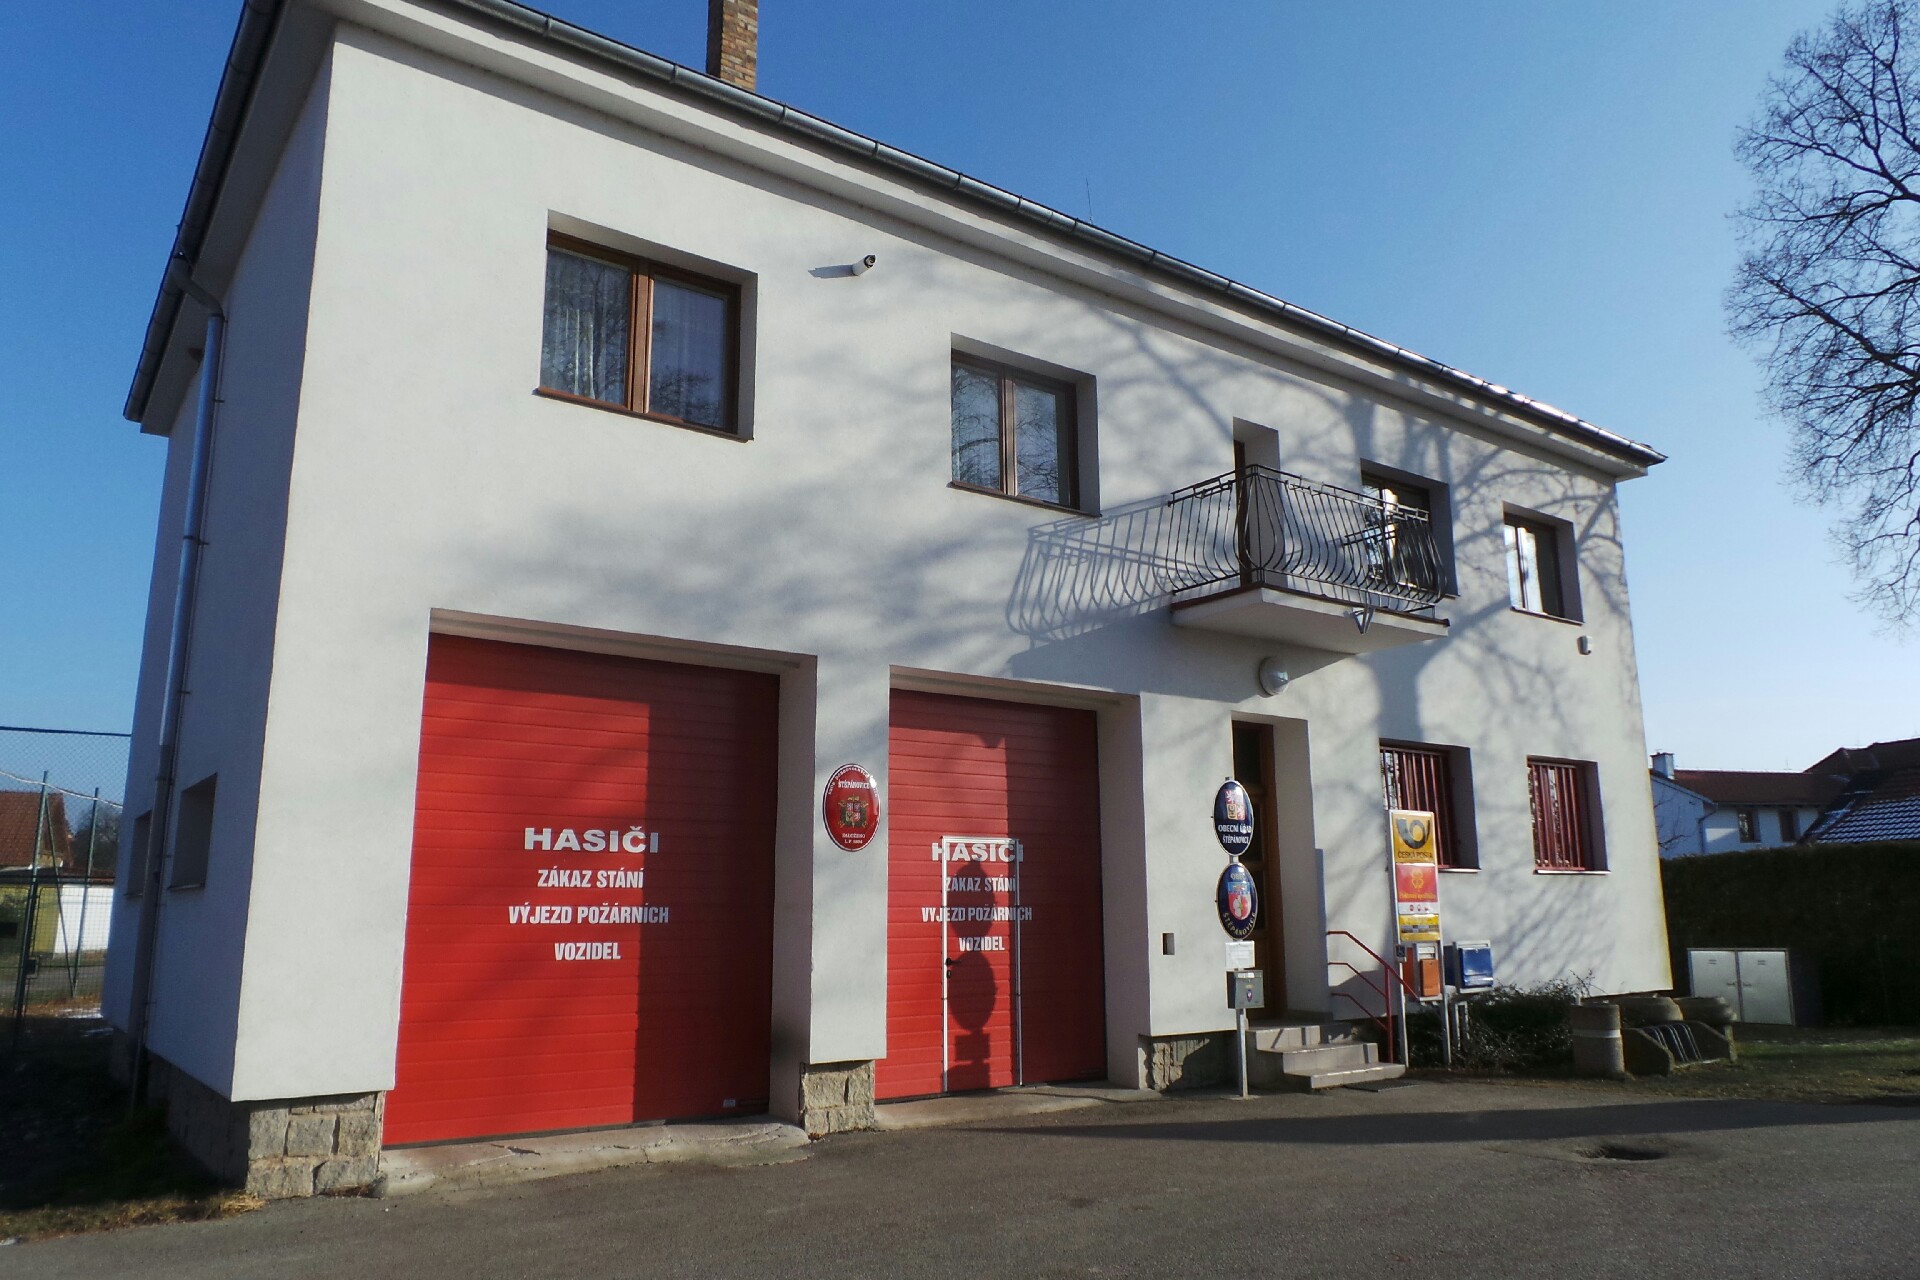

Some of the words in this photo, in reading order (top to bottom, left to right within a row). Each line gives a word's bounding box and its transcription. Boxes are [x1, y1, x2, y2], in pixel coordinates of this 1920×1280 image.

[1218, 823, 1239, 833] OBECNÍ
[524, 825, 659, 854] HASIČI
[931, 840, 1024, 862] HASIČI
[537, 866, 592, 888] ZÁKAZ
[596, 867, 645, 889] STÁNÍ
[945, 874, 981, 892] ZÁKAZ
[984, 874, 1016, 892] STÁNÍ
[508, 902, 572, 924] VÝJEZD
[577, 902, 669, 924] POŽÁRNÍCH
[967, 903, 1033, 921] POŽÁRNÍCH
[554, 942, 621, 961] VOZIDEL
[958, 936, 1005, 952] VOZIDEL
